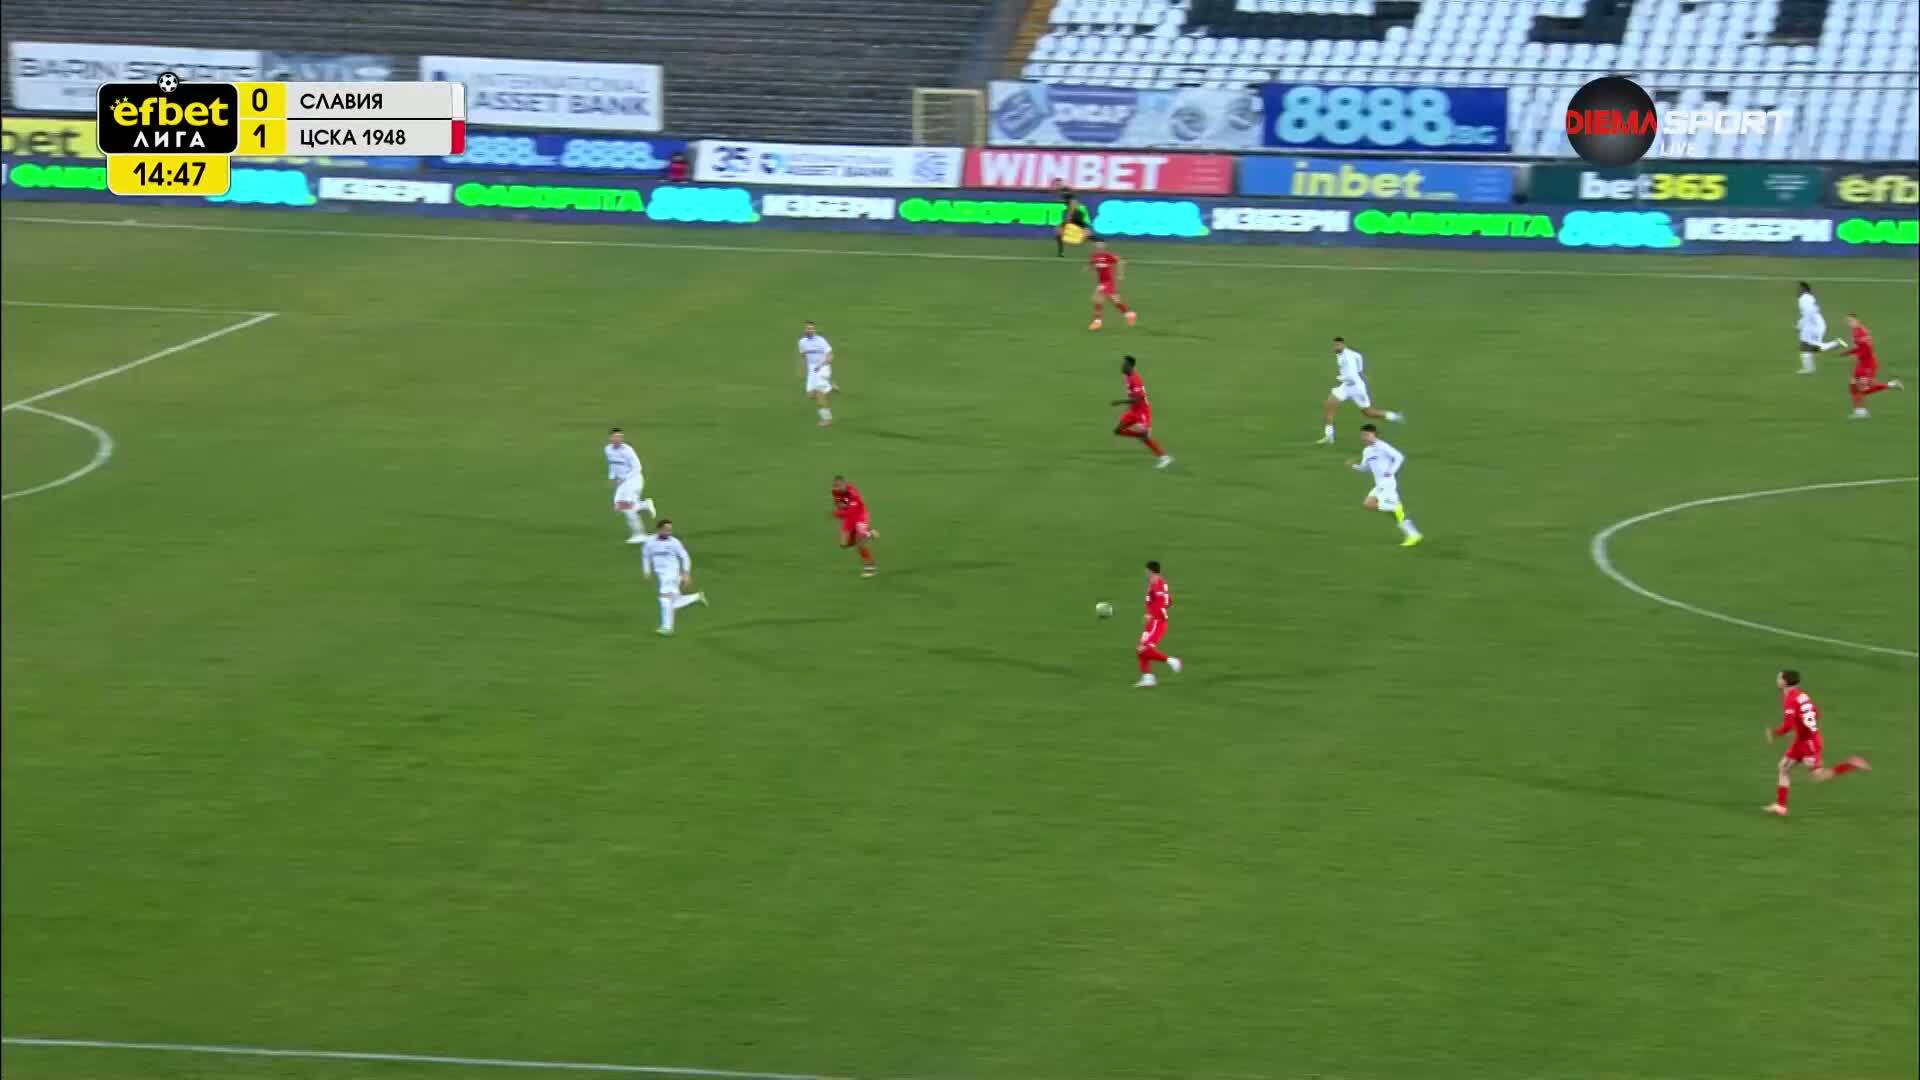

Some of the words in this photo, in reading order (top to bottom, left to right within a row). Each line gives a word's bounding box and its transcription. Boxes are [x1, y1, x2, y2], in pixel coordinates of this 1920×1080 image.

[472, 91, 561, 112] ASSET
[568, 94, 651, 116] BANK
[979, 152, 1168, 191] WINBET
[1579, 172, 1727, 201] bet365
